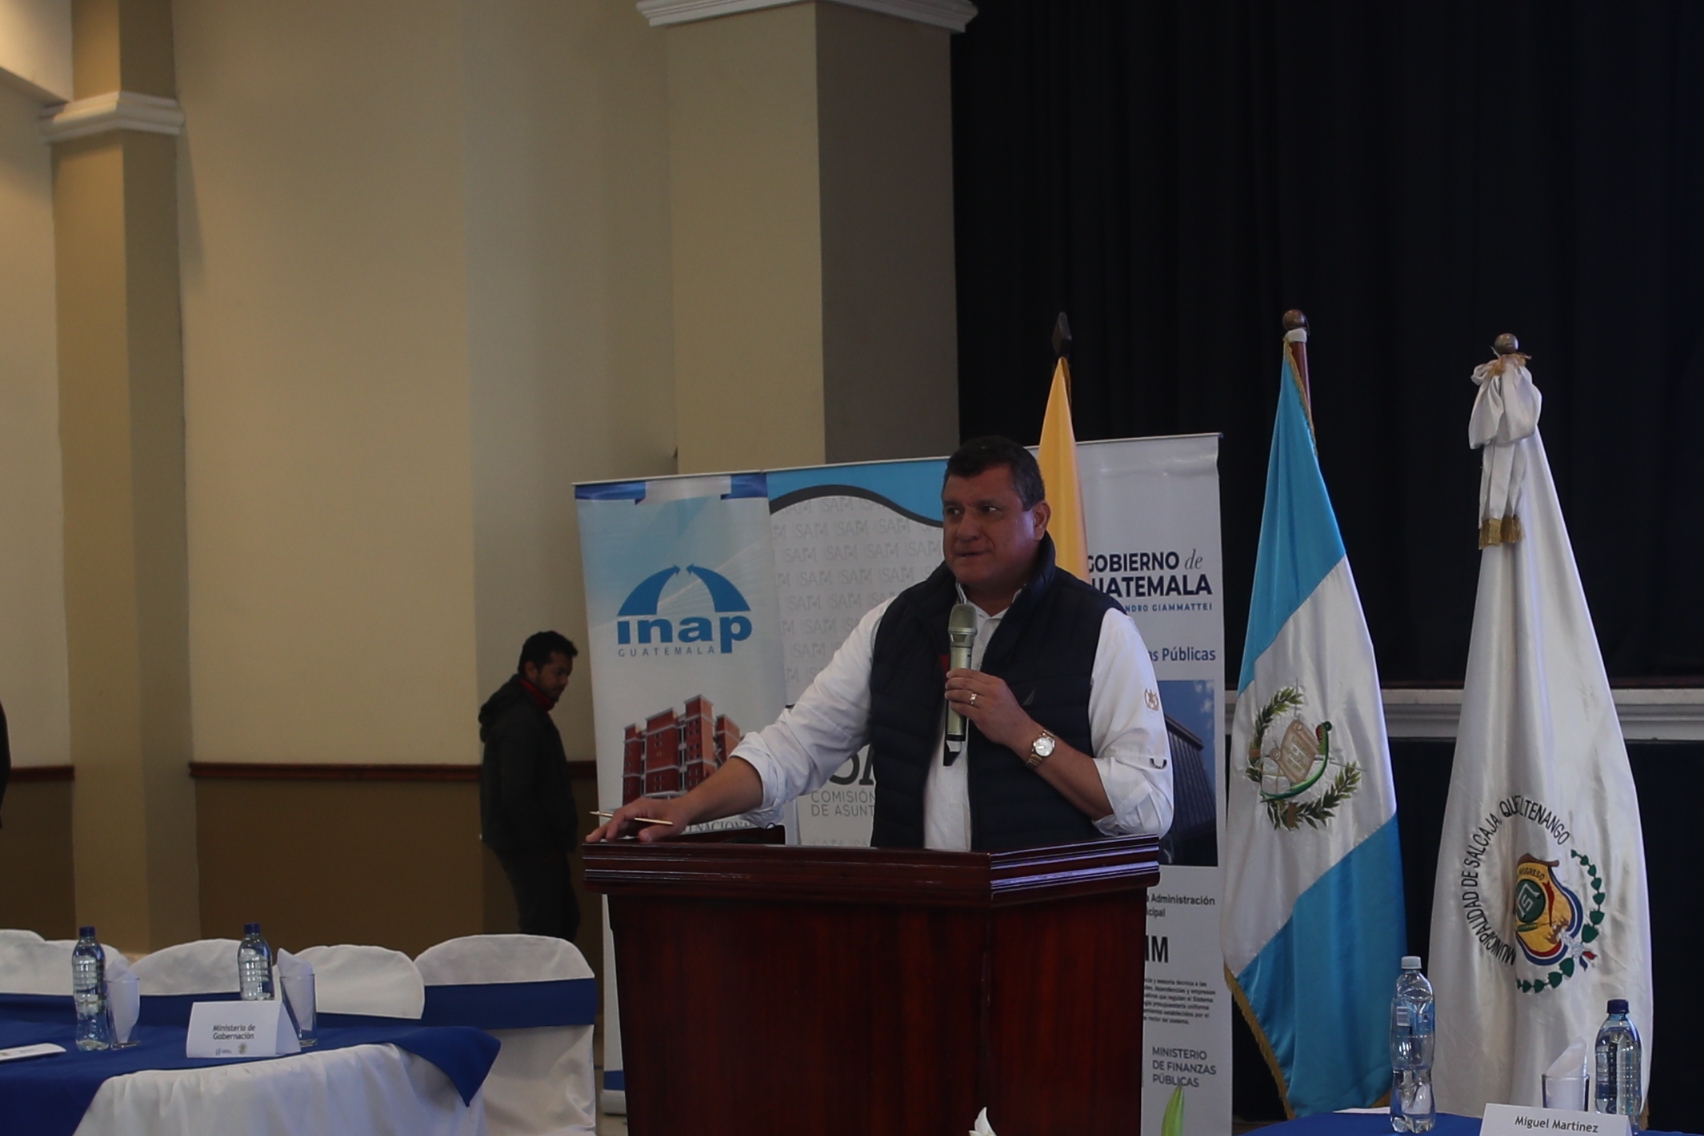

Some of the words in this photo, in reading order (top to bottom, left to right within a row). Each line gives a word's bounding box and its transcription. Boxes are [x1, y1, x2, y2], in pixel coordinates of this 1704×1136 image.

[1184, 549, 1203, 570] de
[1091, 573, 1213, 598] UATEMALA
[1152, 602, 1212, 612] GIAMMATTEI
[617, 615, 753, 654] inap
[618, 646, 715, 658] GUATEMALA
[1162, 646, 1216, 661] Públicas
[811, 804, 829, 816] DE
[835, 804, 875, 816] ASUNT
[1461, 870, 1479, 887] DE
[1151, 893, 1216, 905] Administración
[1462, 891, 1517, 966] MUNICIPALIDAD
[213, 1023, 246, 1032] Ministerio
[248, 1023, 256, 1032] de
[213, 1032, 255, 1041] Gobernación
[1152, 1046, 1208, 1060] MINISTERIO
[1152, 1060, 1165, 1071] DE
[1167, 1061, 1217, 1076] FINANZAS
[1152, 1073, 1200, 1088] PÚBLICAS
[1514, 1116, 1549, 1129] Miguel
